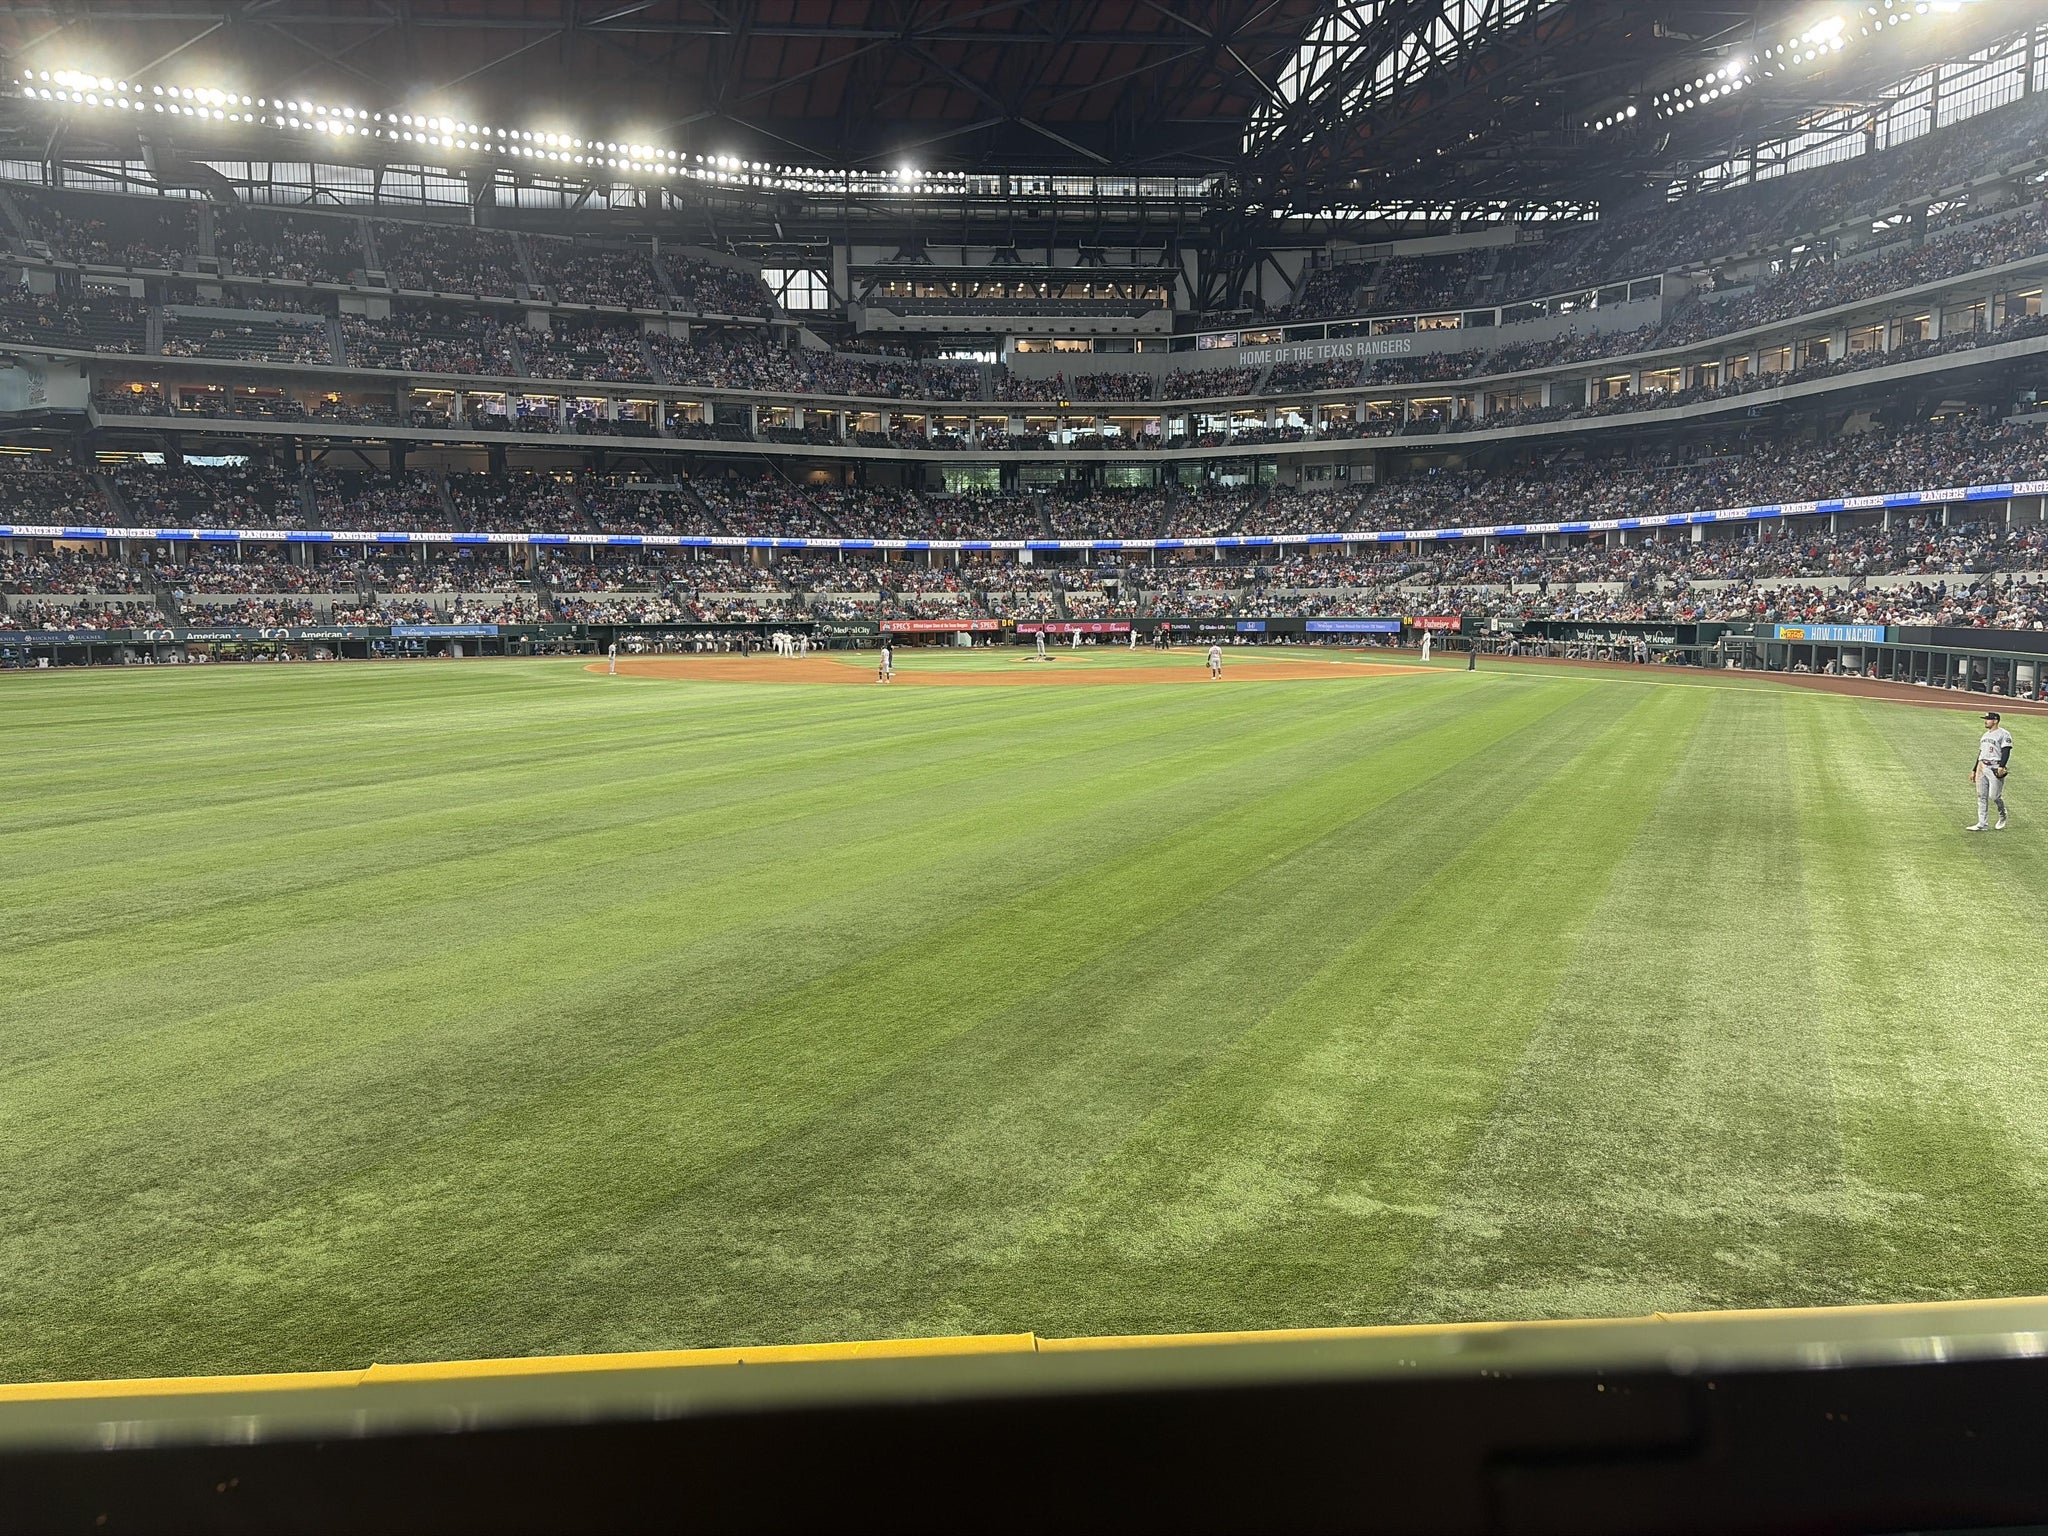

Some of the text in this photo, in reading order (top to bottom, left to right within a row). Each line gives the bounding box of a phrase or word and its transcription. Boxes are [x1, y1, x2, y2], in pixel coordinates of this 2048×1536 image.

[1240, 338, 1411, 365] HOME OF THE TEXAS RANGERS
[1920, 490, 1965, 502] RANGERS
[1844, 498, 1884, 508] RANGERS
[1780, 503, 1817, 513] RANGERS
[1716, 510, 1748, 519] RANGERS
[12, 526, 63, 536] RANGERS
[1526, 524, 1560, 532] RANGERS
[240, 530, 286, 539] RANGERS
[332, 532, 378, 540] RANGERS
[409, 533, 452, 541] RANGERS
[488, 534, 529, 542] RANGERS
[980, 622, 998, 630] SPEC'S
[1424, 619, 1449, 628] Budweiser
[858, 626, 870, 635] City
[1585, 629, 1604, 640] Kroger
[1811, 627, 1830, 640] HOW
[1833, 627, 1842, 641] TO
[1846, 628, 1876, 642] NACHO!
[1617, 630, 1639, 643] Kroger
[1653, 631, 1675, 644] Kroger
